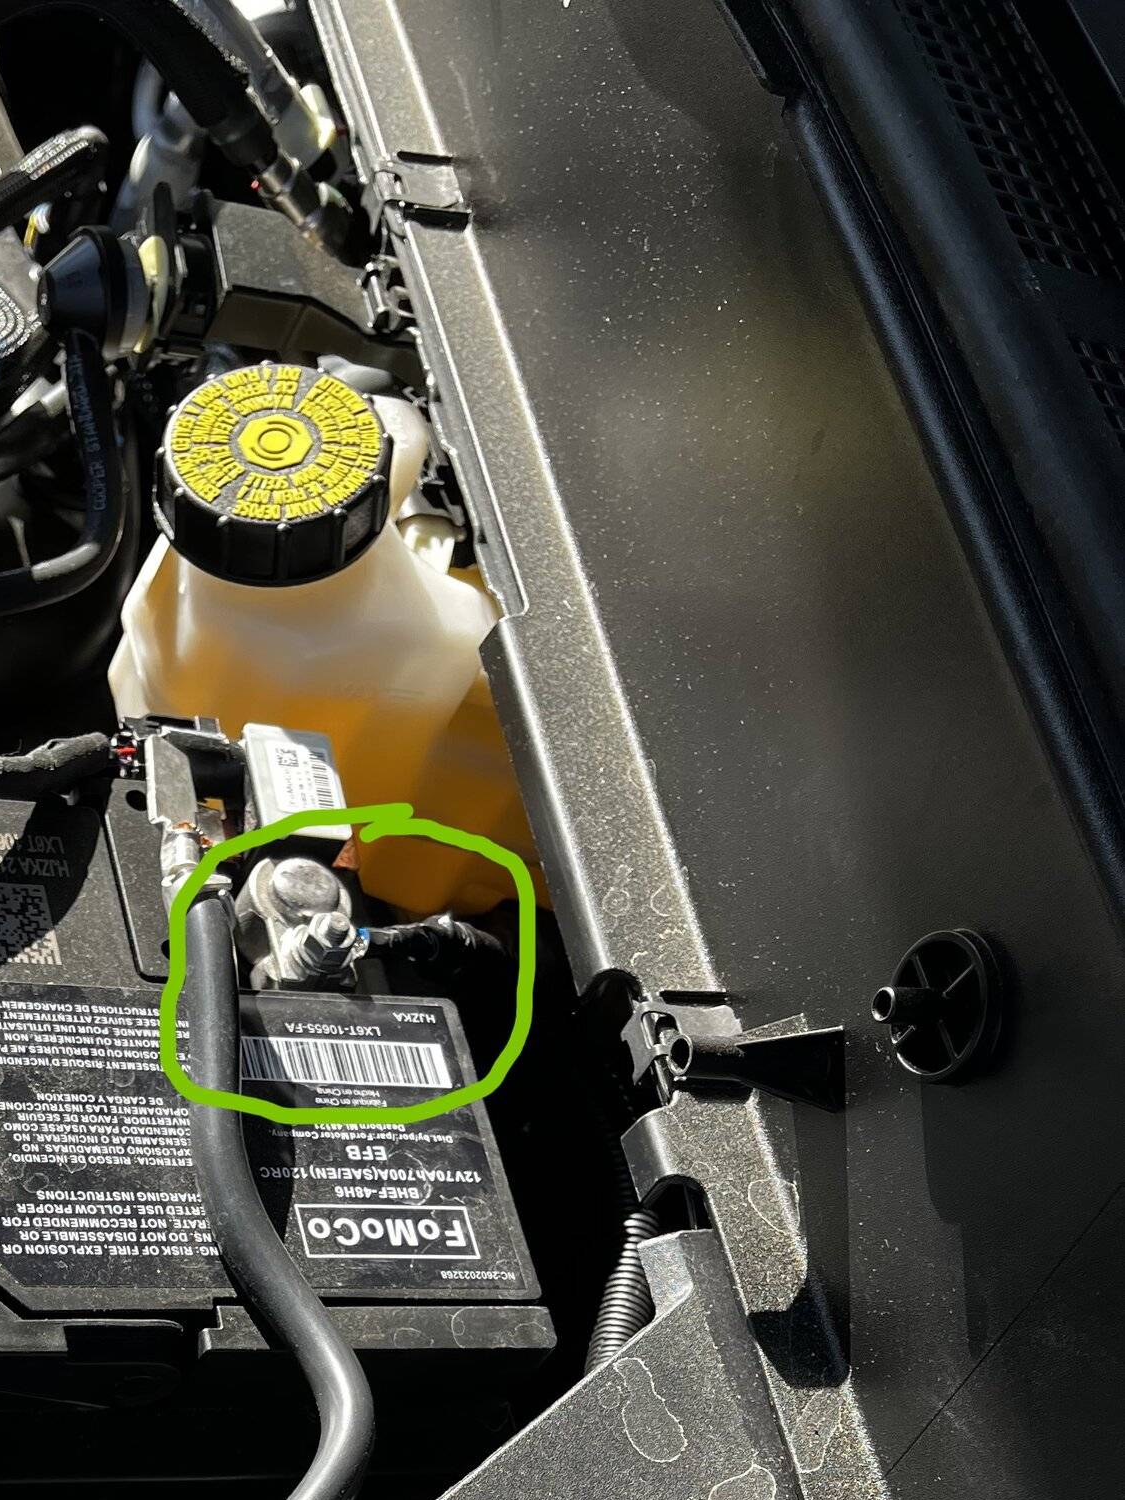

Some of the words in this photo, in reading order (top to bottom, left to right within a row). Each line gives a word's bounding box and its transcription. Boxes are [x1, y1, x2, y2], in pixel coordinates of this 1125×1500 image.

[19, 857, 70, 878] HJZKA
[75, 1004, 90, 1013] DE
[3, 1011, 92, 1024] ATTENTIVEMENT
[94, 1016, 133, 1026] SUIVEZ
[393, 1012, 435, 1024] HJZKA
[54, 1023, 76, 1033] UNE
[78, 1025, 108, 1034] POUR
[284, 1021, 381, 1037] LX6T-10655-FA
[3, 1032, 29, 1042] NON
[96, 1037, 112, 1046] OU
[10, 1044, 25, 1053] NE
[90, 1048, 104, 1056] DE
[36, 1093, 95, 1103] CONEXIÓN
[105, 1094, 146, 1105] CARGA
[149, 1097, 163, 1106] DE
[85, 1104, 108, 1114] LAS
[17, 1112, 60, 1122] SEGUIR
[63, 1114, 78, 1122] DE
[81, 1114, 118, 1124] FAVOR
[4, 1122, 38, 1131] COMO
[12, 1132, 30, 1142] NO
[100, 1135, 109, 1143] O
[21, 1143, 39, 1152] NO
[345, 1145, 387, 1160] EFB
[70, 1155, 85, 1164] DE
[88, 1155, 131, 1165] RIESGO
[36, 1190, 134, 1201] INSTRUCTIONS
[334, 1185, 419, 1198] BHEF-48H6
[16, 1203, 73, 1214] PROPER
[75, 1204, 131, 1214] FOLLOW
[133, 1204, 163, 1214] USE.
[1, 1216, 30, 1227] FOR
[33, 1217, 137, 1227] RECOMMENDED
[140, 1218, 167, 1228] NOT
[19, 1230, 40, 1240] OR
[42, 1231, 136, 1242] DISASSEMBLE
[139, 1232, 166, 1241] NOT
[168, 1232, 188, 1242] DO
[307, 1217, 467, 1247] FoMoCo
[1, 1243, 23, 1254] OR
[25, 1244, 103, 1255] EXPLOSION
[142, 1245, 159, 1255] OF
[162, 1246, 193, 1255] RISK
[441, 1270, 515, 1280] NC:2602023268
